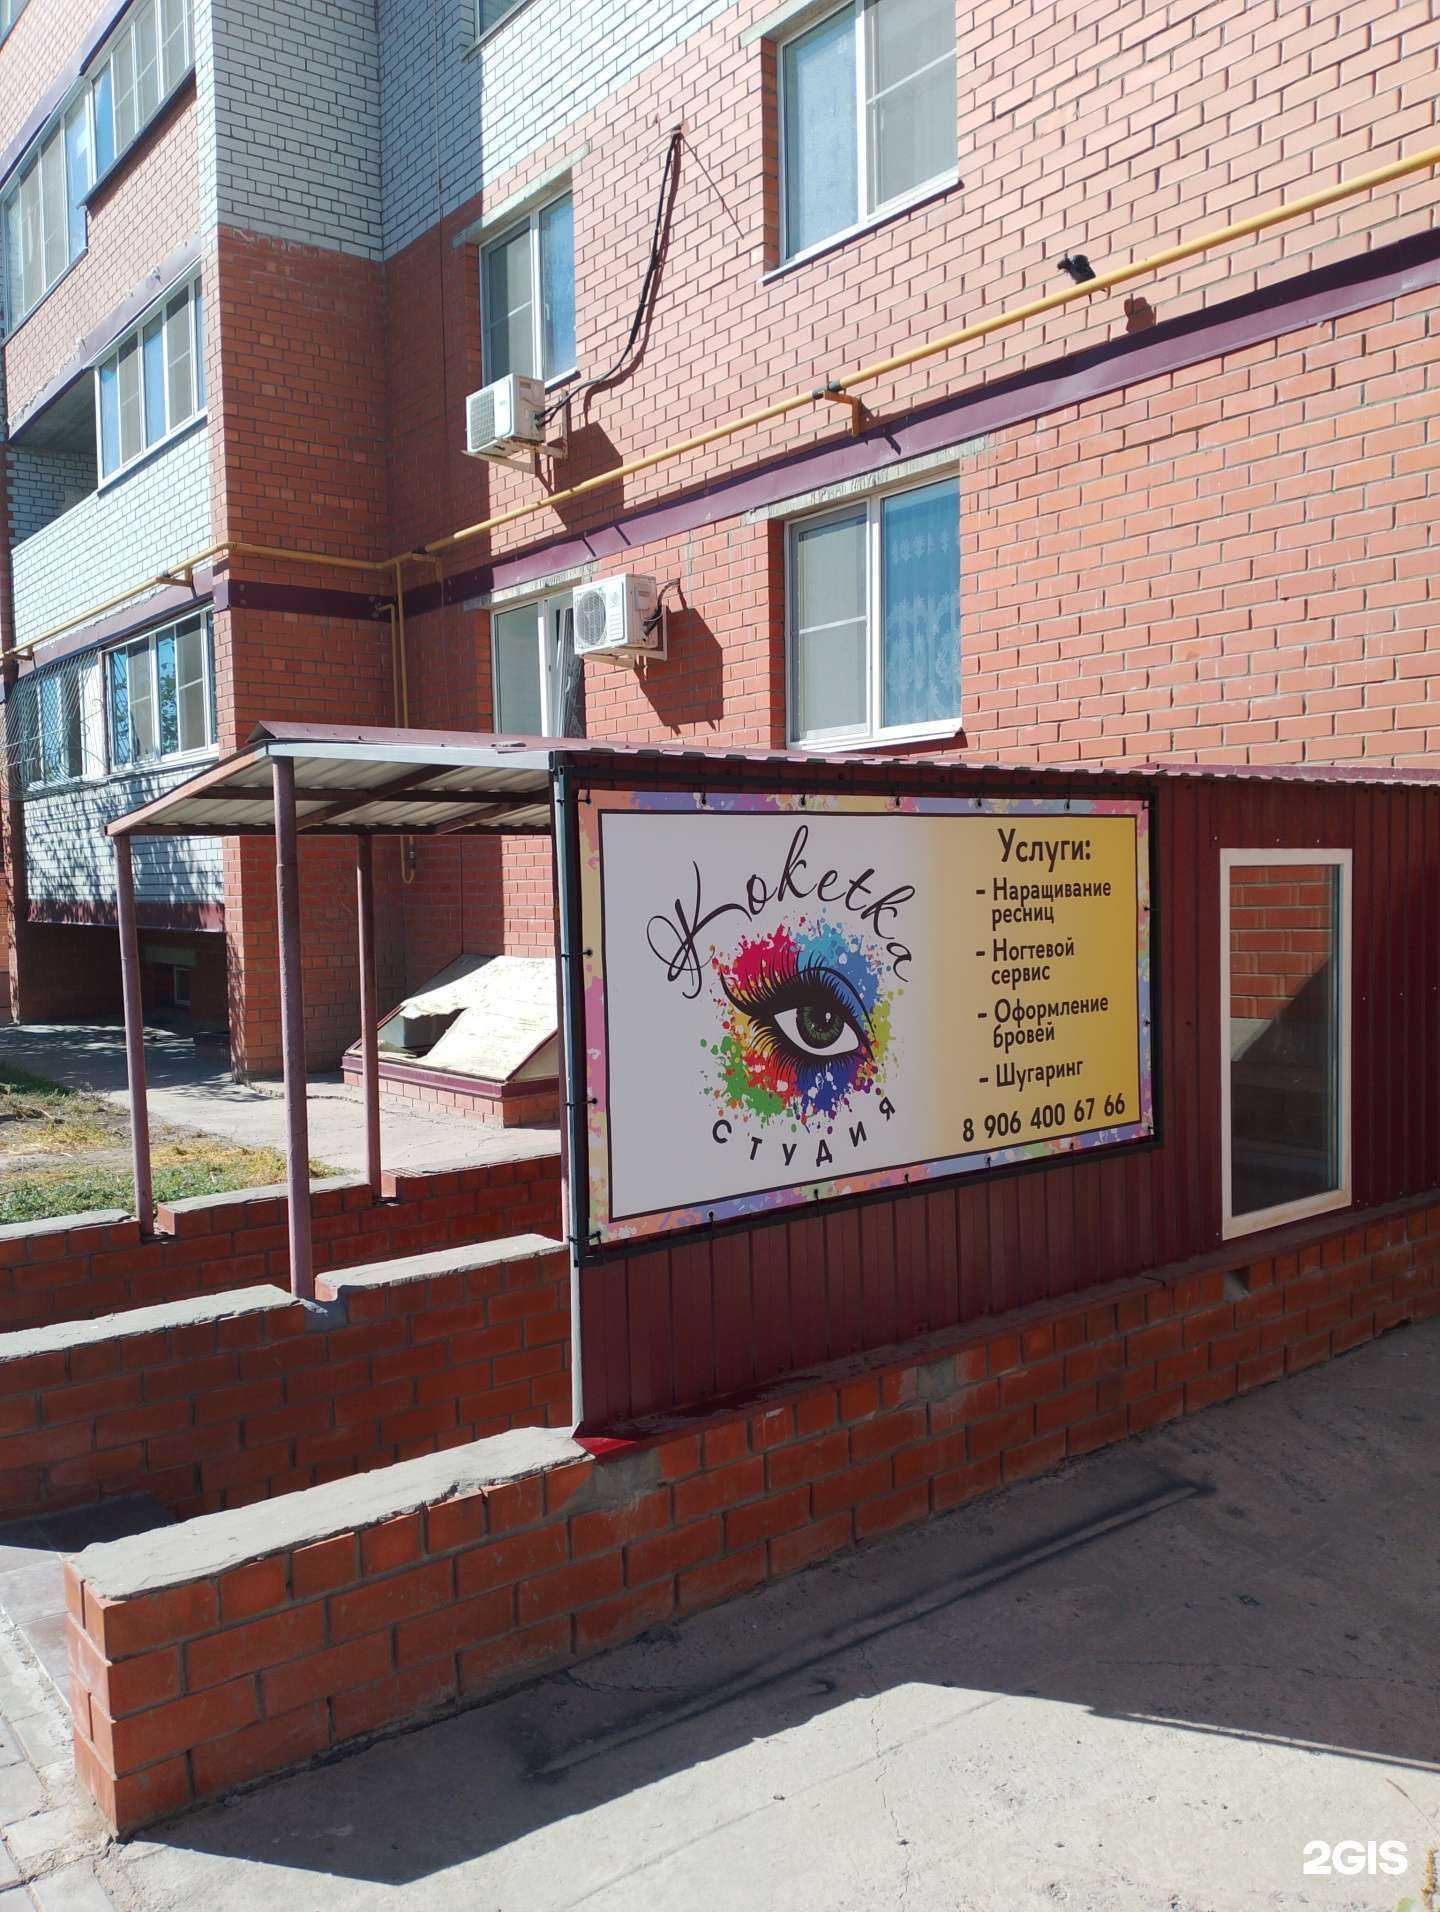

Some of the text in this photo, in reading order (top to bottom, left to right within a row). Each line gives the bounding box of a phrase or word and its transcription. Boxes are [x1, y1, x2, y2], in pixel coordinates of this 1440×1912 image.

[997, 828, 1092, 873] Услуги:
[993, 877, 1112, 907] Наращивание
[991, 905, 1054, 932] ресниц
[993, 937, 1075, 962] Ногтевой
[991, 965, 1050, 991] сервис
[994, 996, 1109, 1028] Оформление
[993, 1021, 1055, 1054] бровей
[996, 1061, 1084, 1092] Шугаринг
[962, 1092, 1126, 1142] 8 906 400 67 66
